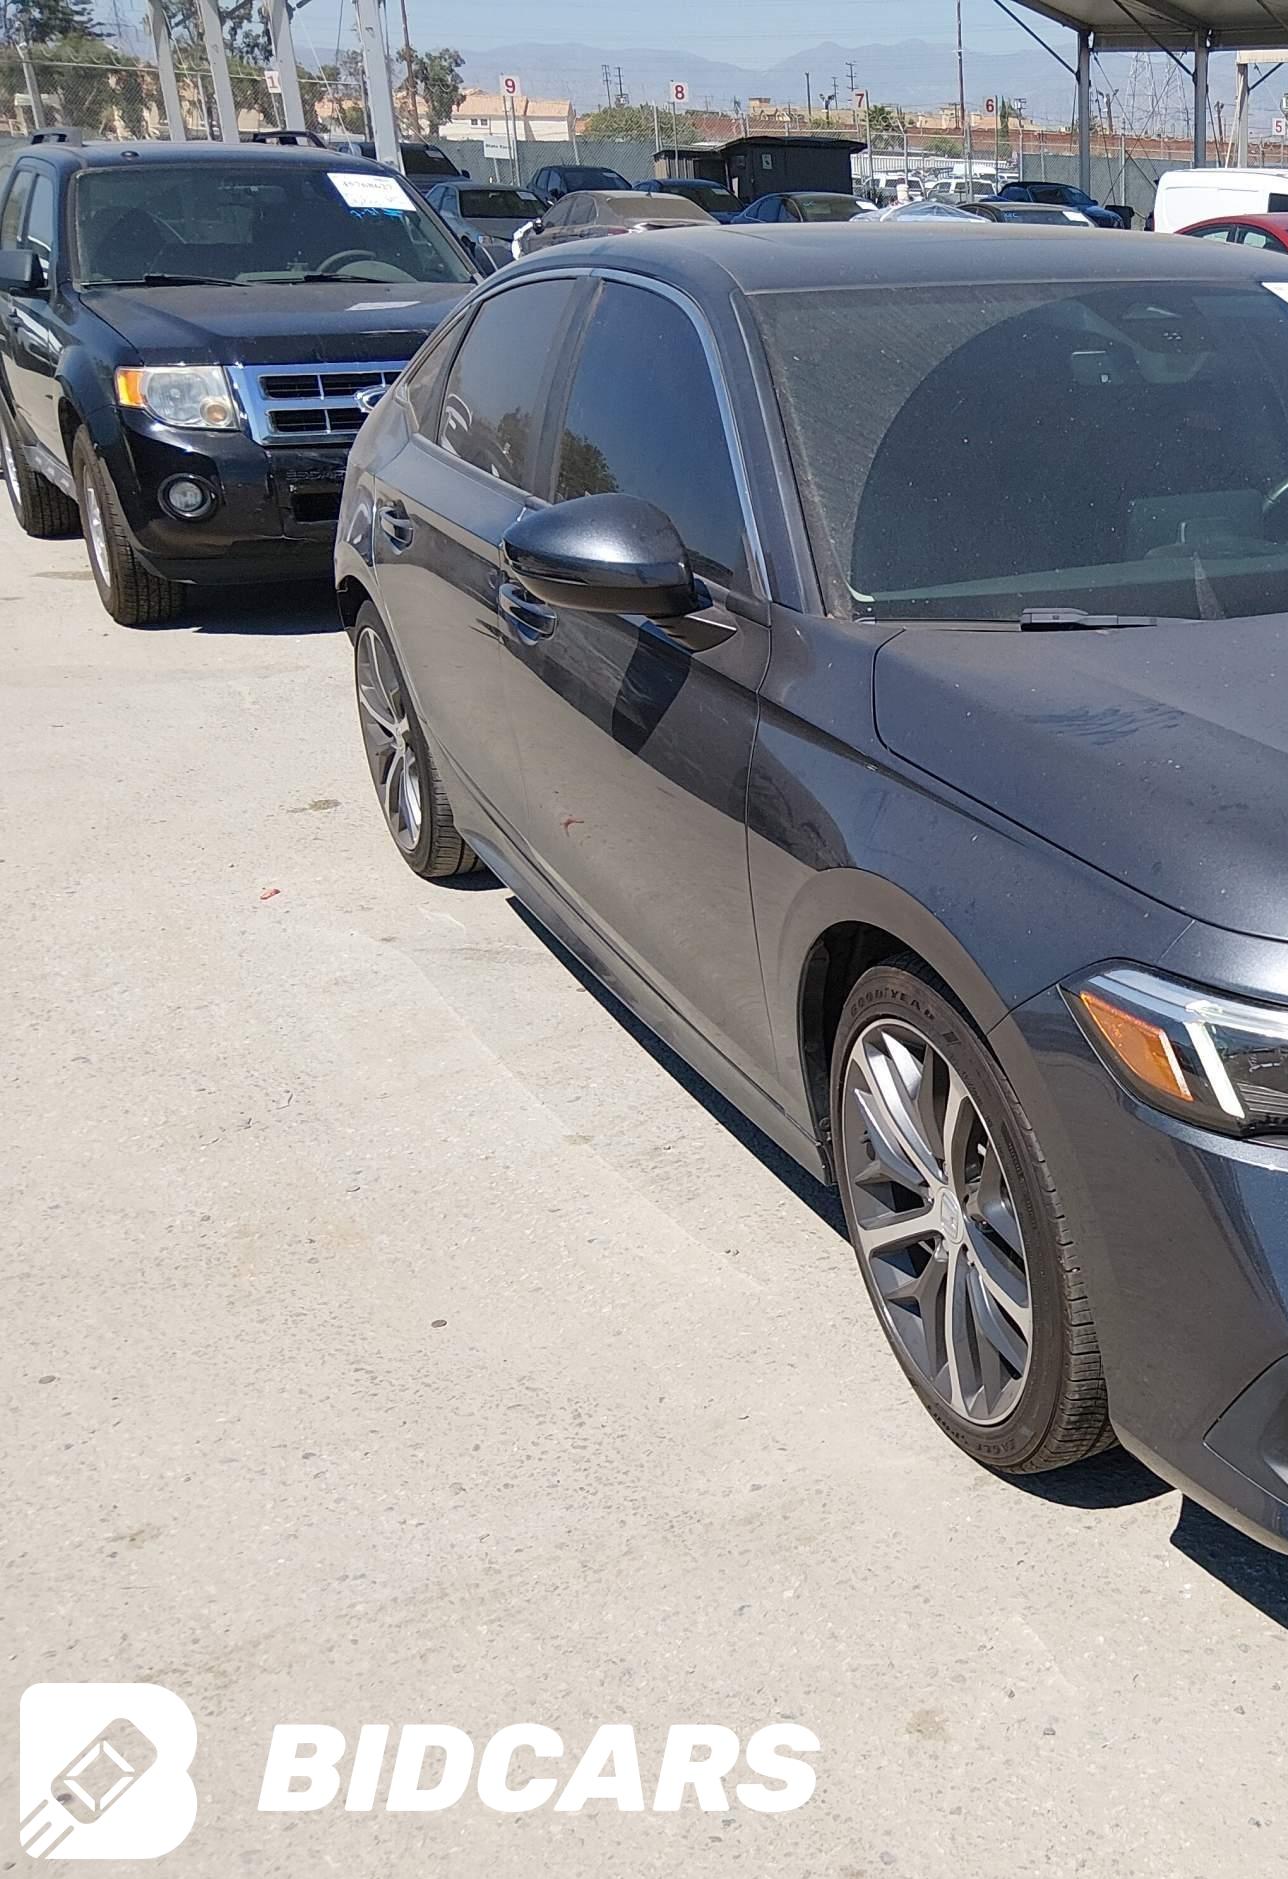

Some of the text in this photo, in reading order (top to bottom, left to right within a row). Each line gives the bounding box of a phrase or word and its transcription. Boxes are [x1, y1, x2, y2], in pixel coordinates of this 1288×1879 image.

[504, 78, 516, 94] 9
[674, 84, 685, 100] 8
[855, 93, 865, 108] 7
[985, 98, 995, 113] 6
[1275, 120, 1283, 133] 5
